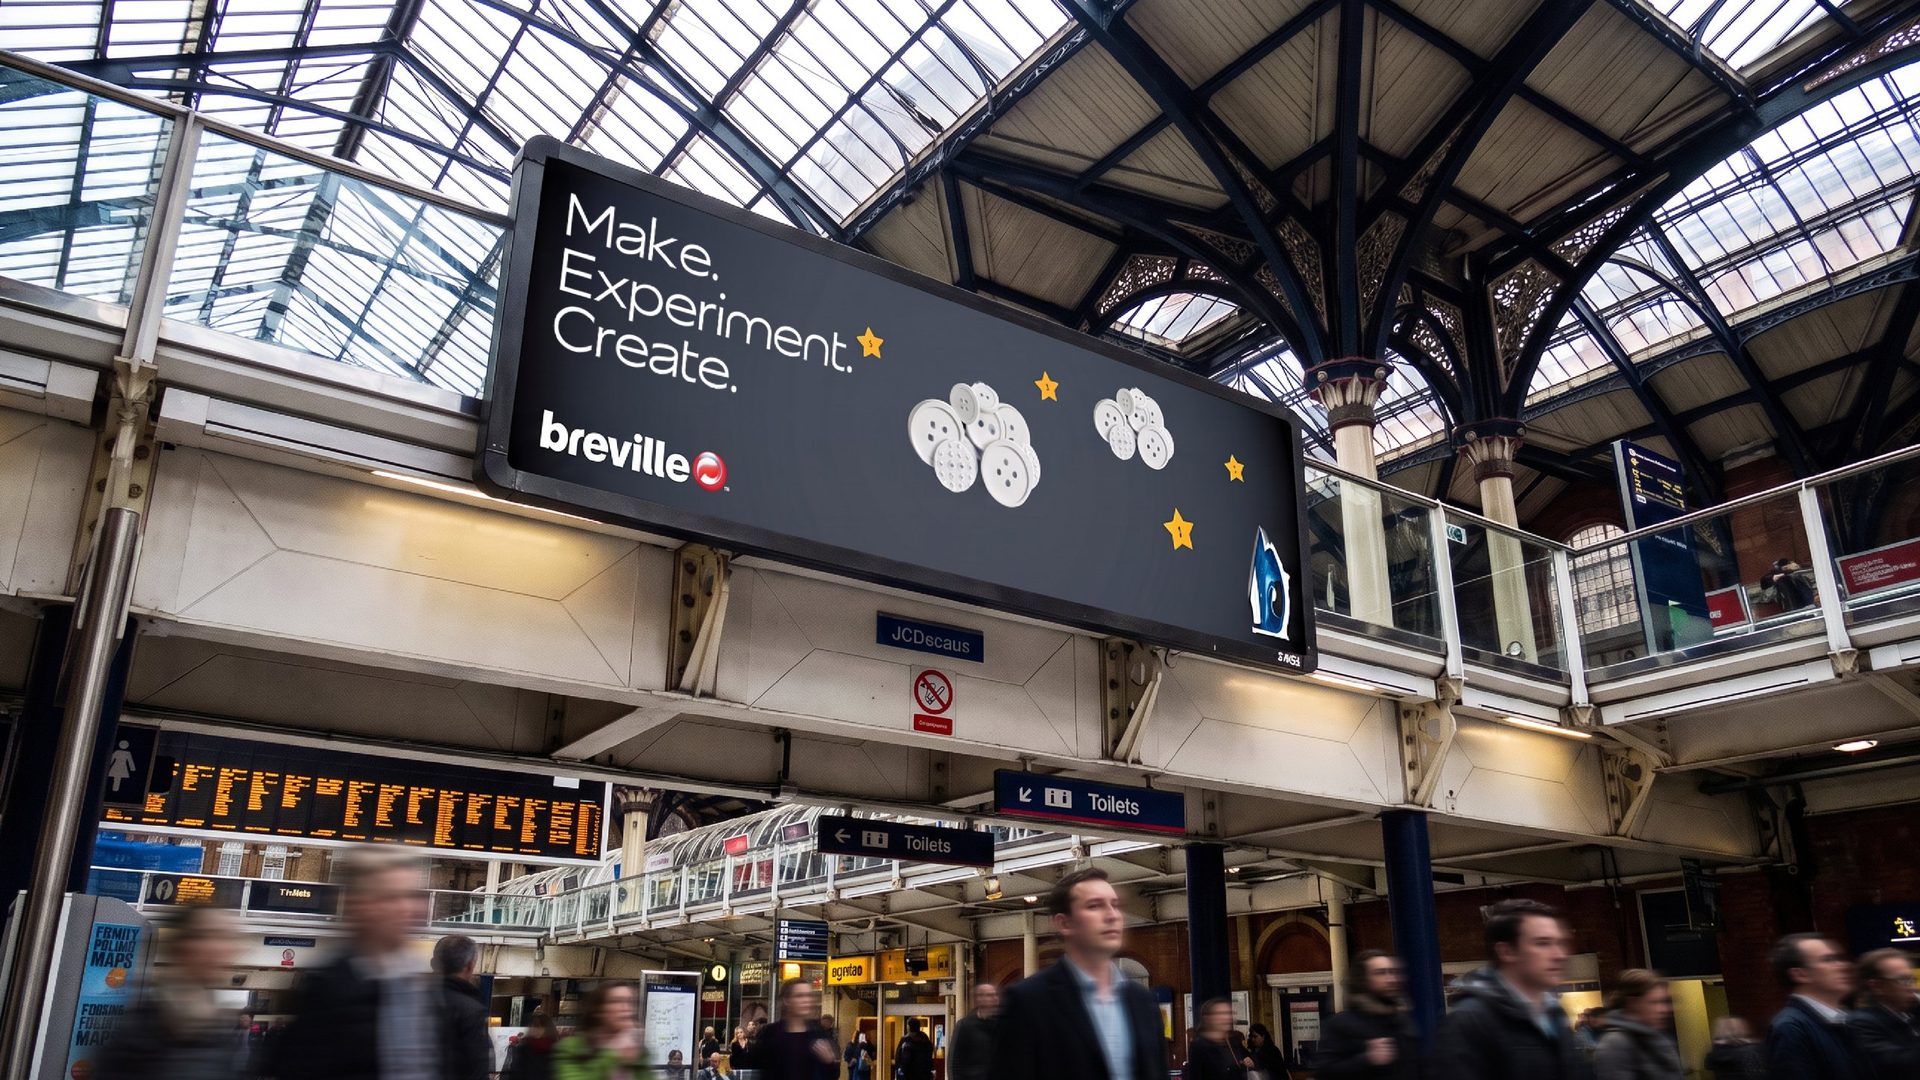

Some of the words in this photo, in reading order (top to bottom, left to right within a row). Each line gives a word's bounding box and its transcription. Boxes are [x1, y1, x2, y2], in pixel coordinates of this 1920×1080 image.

[565, 192, 719, 281] Make.
[559, 248, 853, 373] Experiment.
[553, 306, 737, 393] Create.
[539, 409, 690, 483] breville
[1088, 793, 1140, 816] Toilets
[904, 835, 951, 853] Toilets
[89, 951, 134, 969] MAPS
[75, 1029, 115, 1046] MAP
